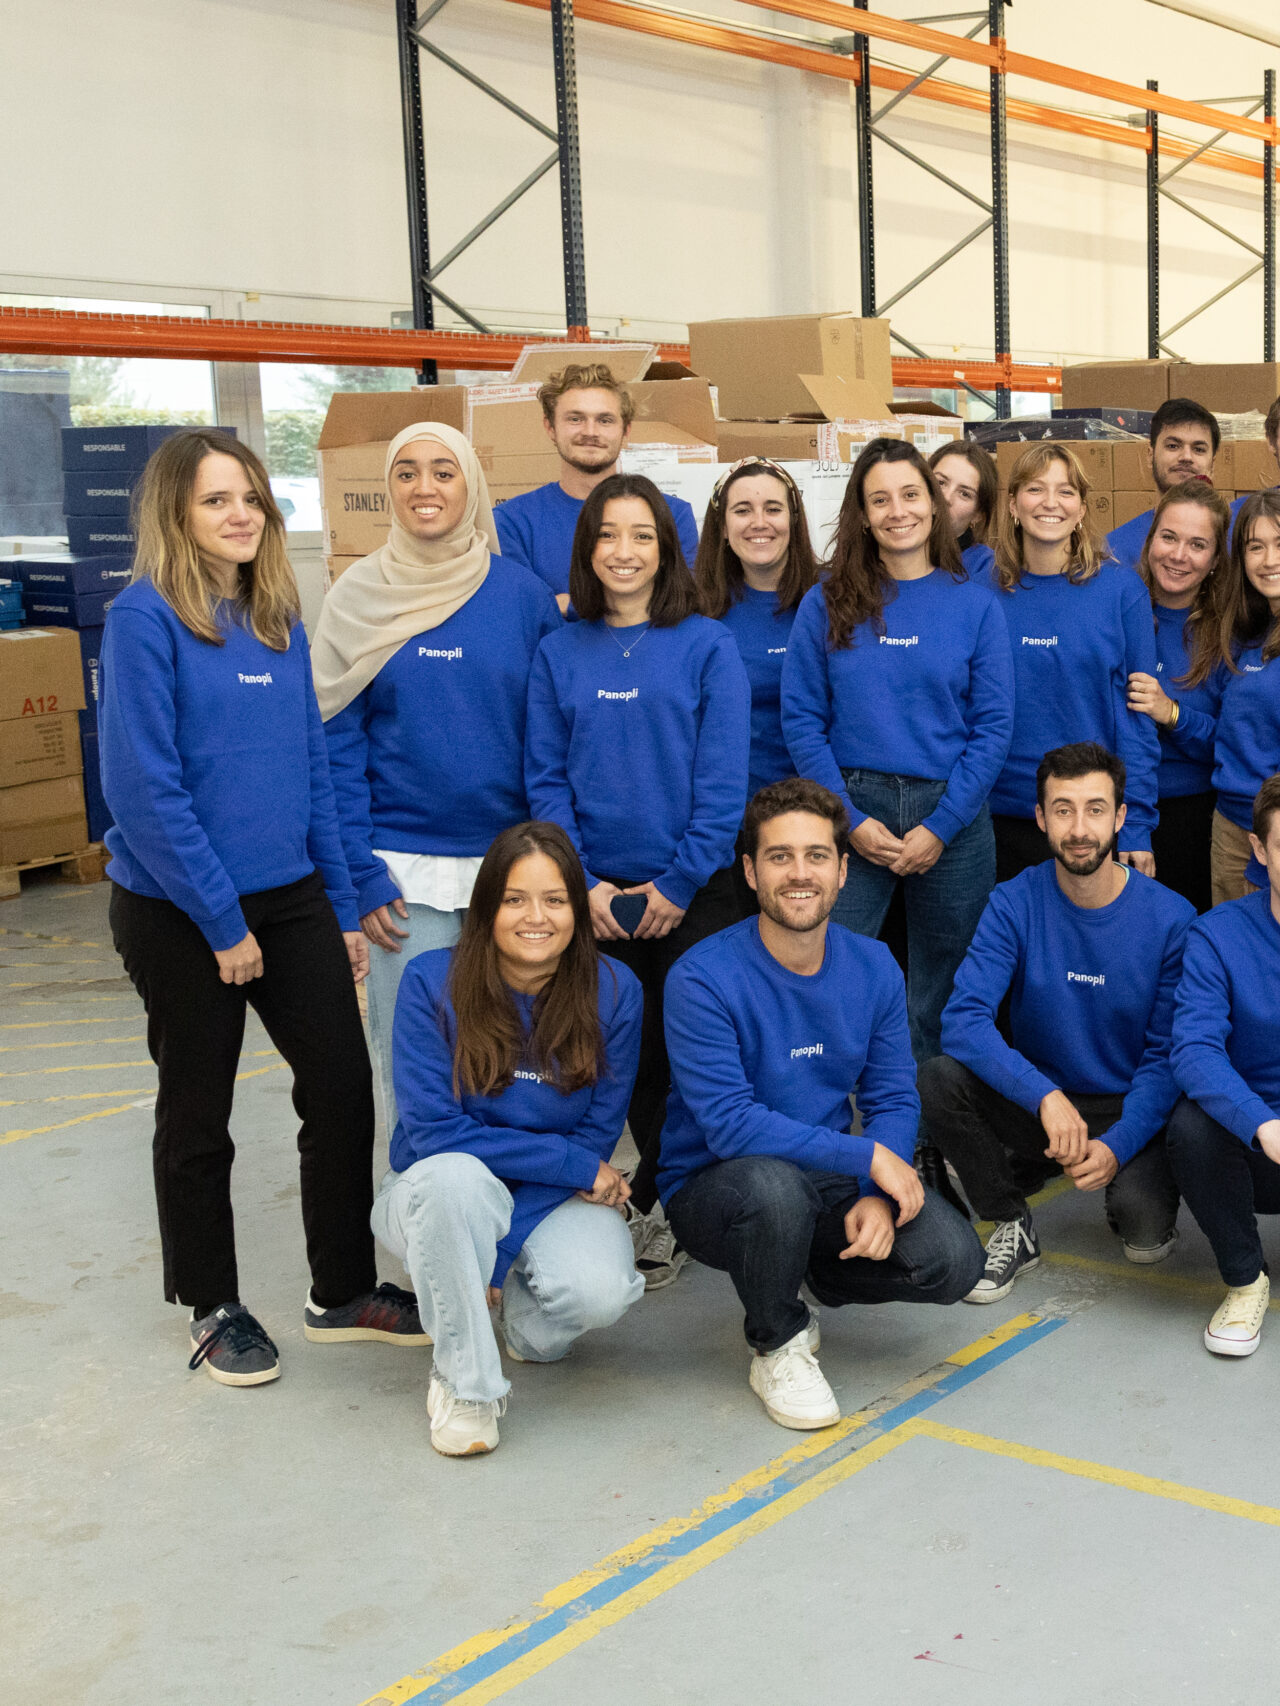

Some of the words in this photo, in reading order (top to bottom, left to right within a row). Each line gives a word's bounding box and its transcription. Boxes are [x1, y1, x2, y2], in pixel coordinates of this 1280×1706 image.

[83, 444, 126, 452] RESPONSABLE
[87, 488, 130, 497] RESPONSABLE
[89, 534, 135, 542] RESPONSABLE
[29, 574, 66, 582] RESPONSABLE
[33, 605, 69, 613] RESPONSABLE
[880, 635, 919, 648] Panopli
[1022, 635, 1058, 648] Panopli
[418, 646, 463, 661] Panopli
[237, 672, 273, 687] Panopli
[598, 687, 639, 702] Panopli
[22, 695, 58, 716] A12
[1068, 971, 1106, 987] Panopli
[791, 1042, 824, 1059] Panopli
